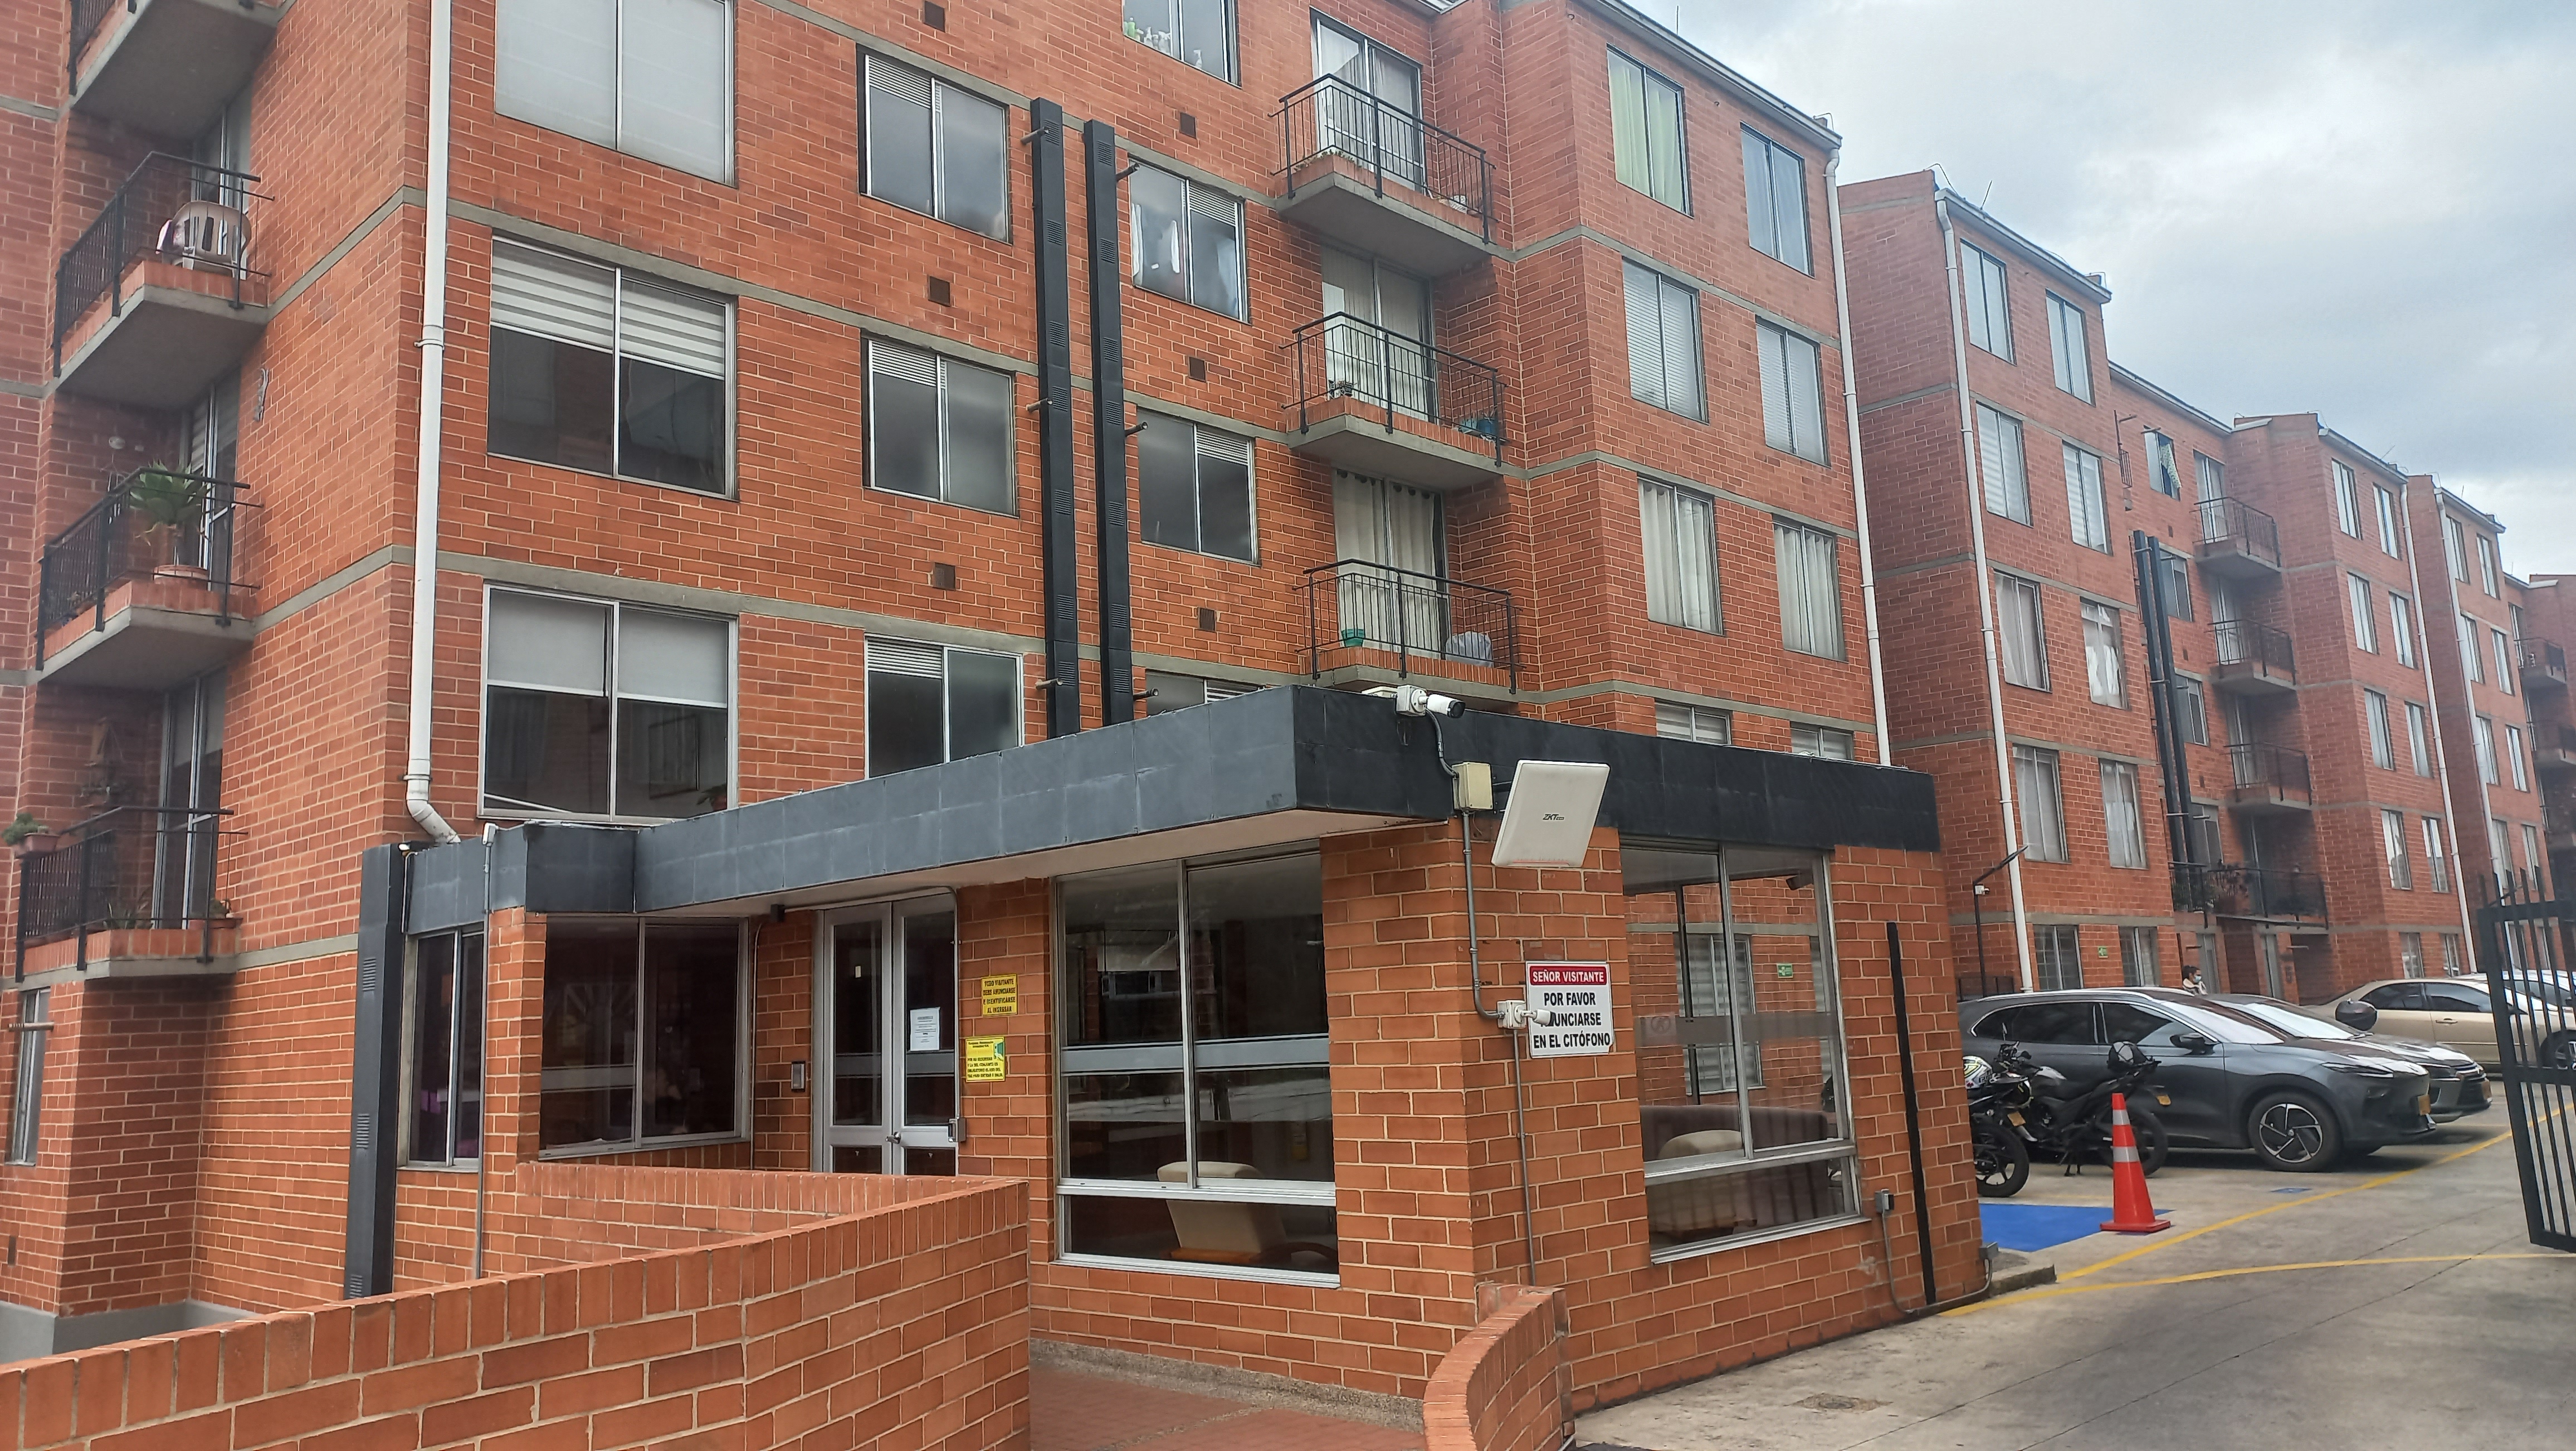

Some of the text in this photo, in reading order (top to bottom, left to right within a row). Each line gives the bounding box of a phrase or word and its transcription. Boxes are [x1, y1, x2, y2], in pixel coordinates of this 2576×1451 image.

[1533, 969, 1604, 982] SEÑOR VISITANTE
[1544, 992, 1596, 1006] POR FAVOR
[1540, 1012, 1602, 1027] UNCIARSE
[1533, 1030, 1611, 1049] EN EL CITÓFONO
